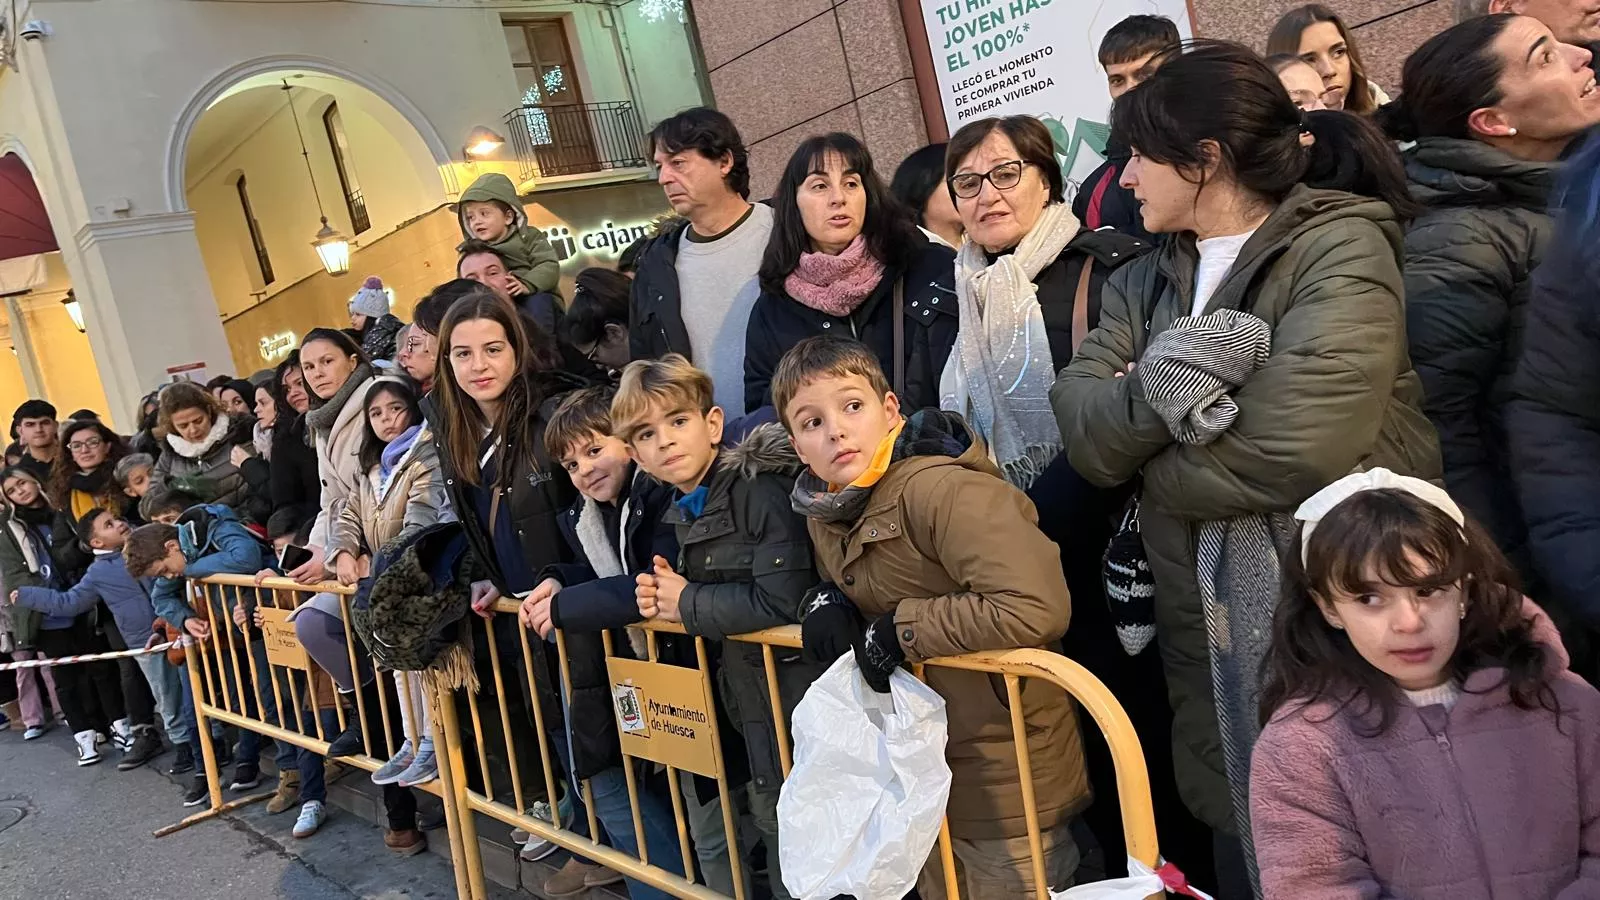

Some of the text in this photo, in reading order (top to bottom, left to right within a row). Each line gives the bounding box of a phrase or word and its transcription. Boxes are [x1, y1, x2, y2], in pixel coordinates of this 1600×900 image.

[936, 1, 961, 25] TU
[943, 7, 1006, 49] JOVEN
[946, 51, 970, 72] EL
[952, 46, 1053, 93] LLEGÓ EL MOMENTO
[955, 68, 1036, 107] DE COMPRAR TU
[958, 77, 1055, 120] PRIMERA VIVIENDA
[582, 222, 649, 254] cajam
[648, 698, 706, 723] Ayuntamiento
[651, 717, 696, 739] de Huesca
